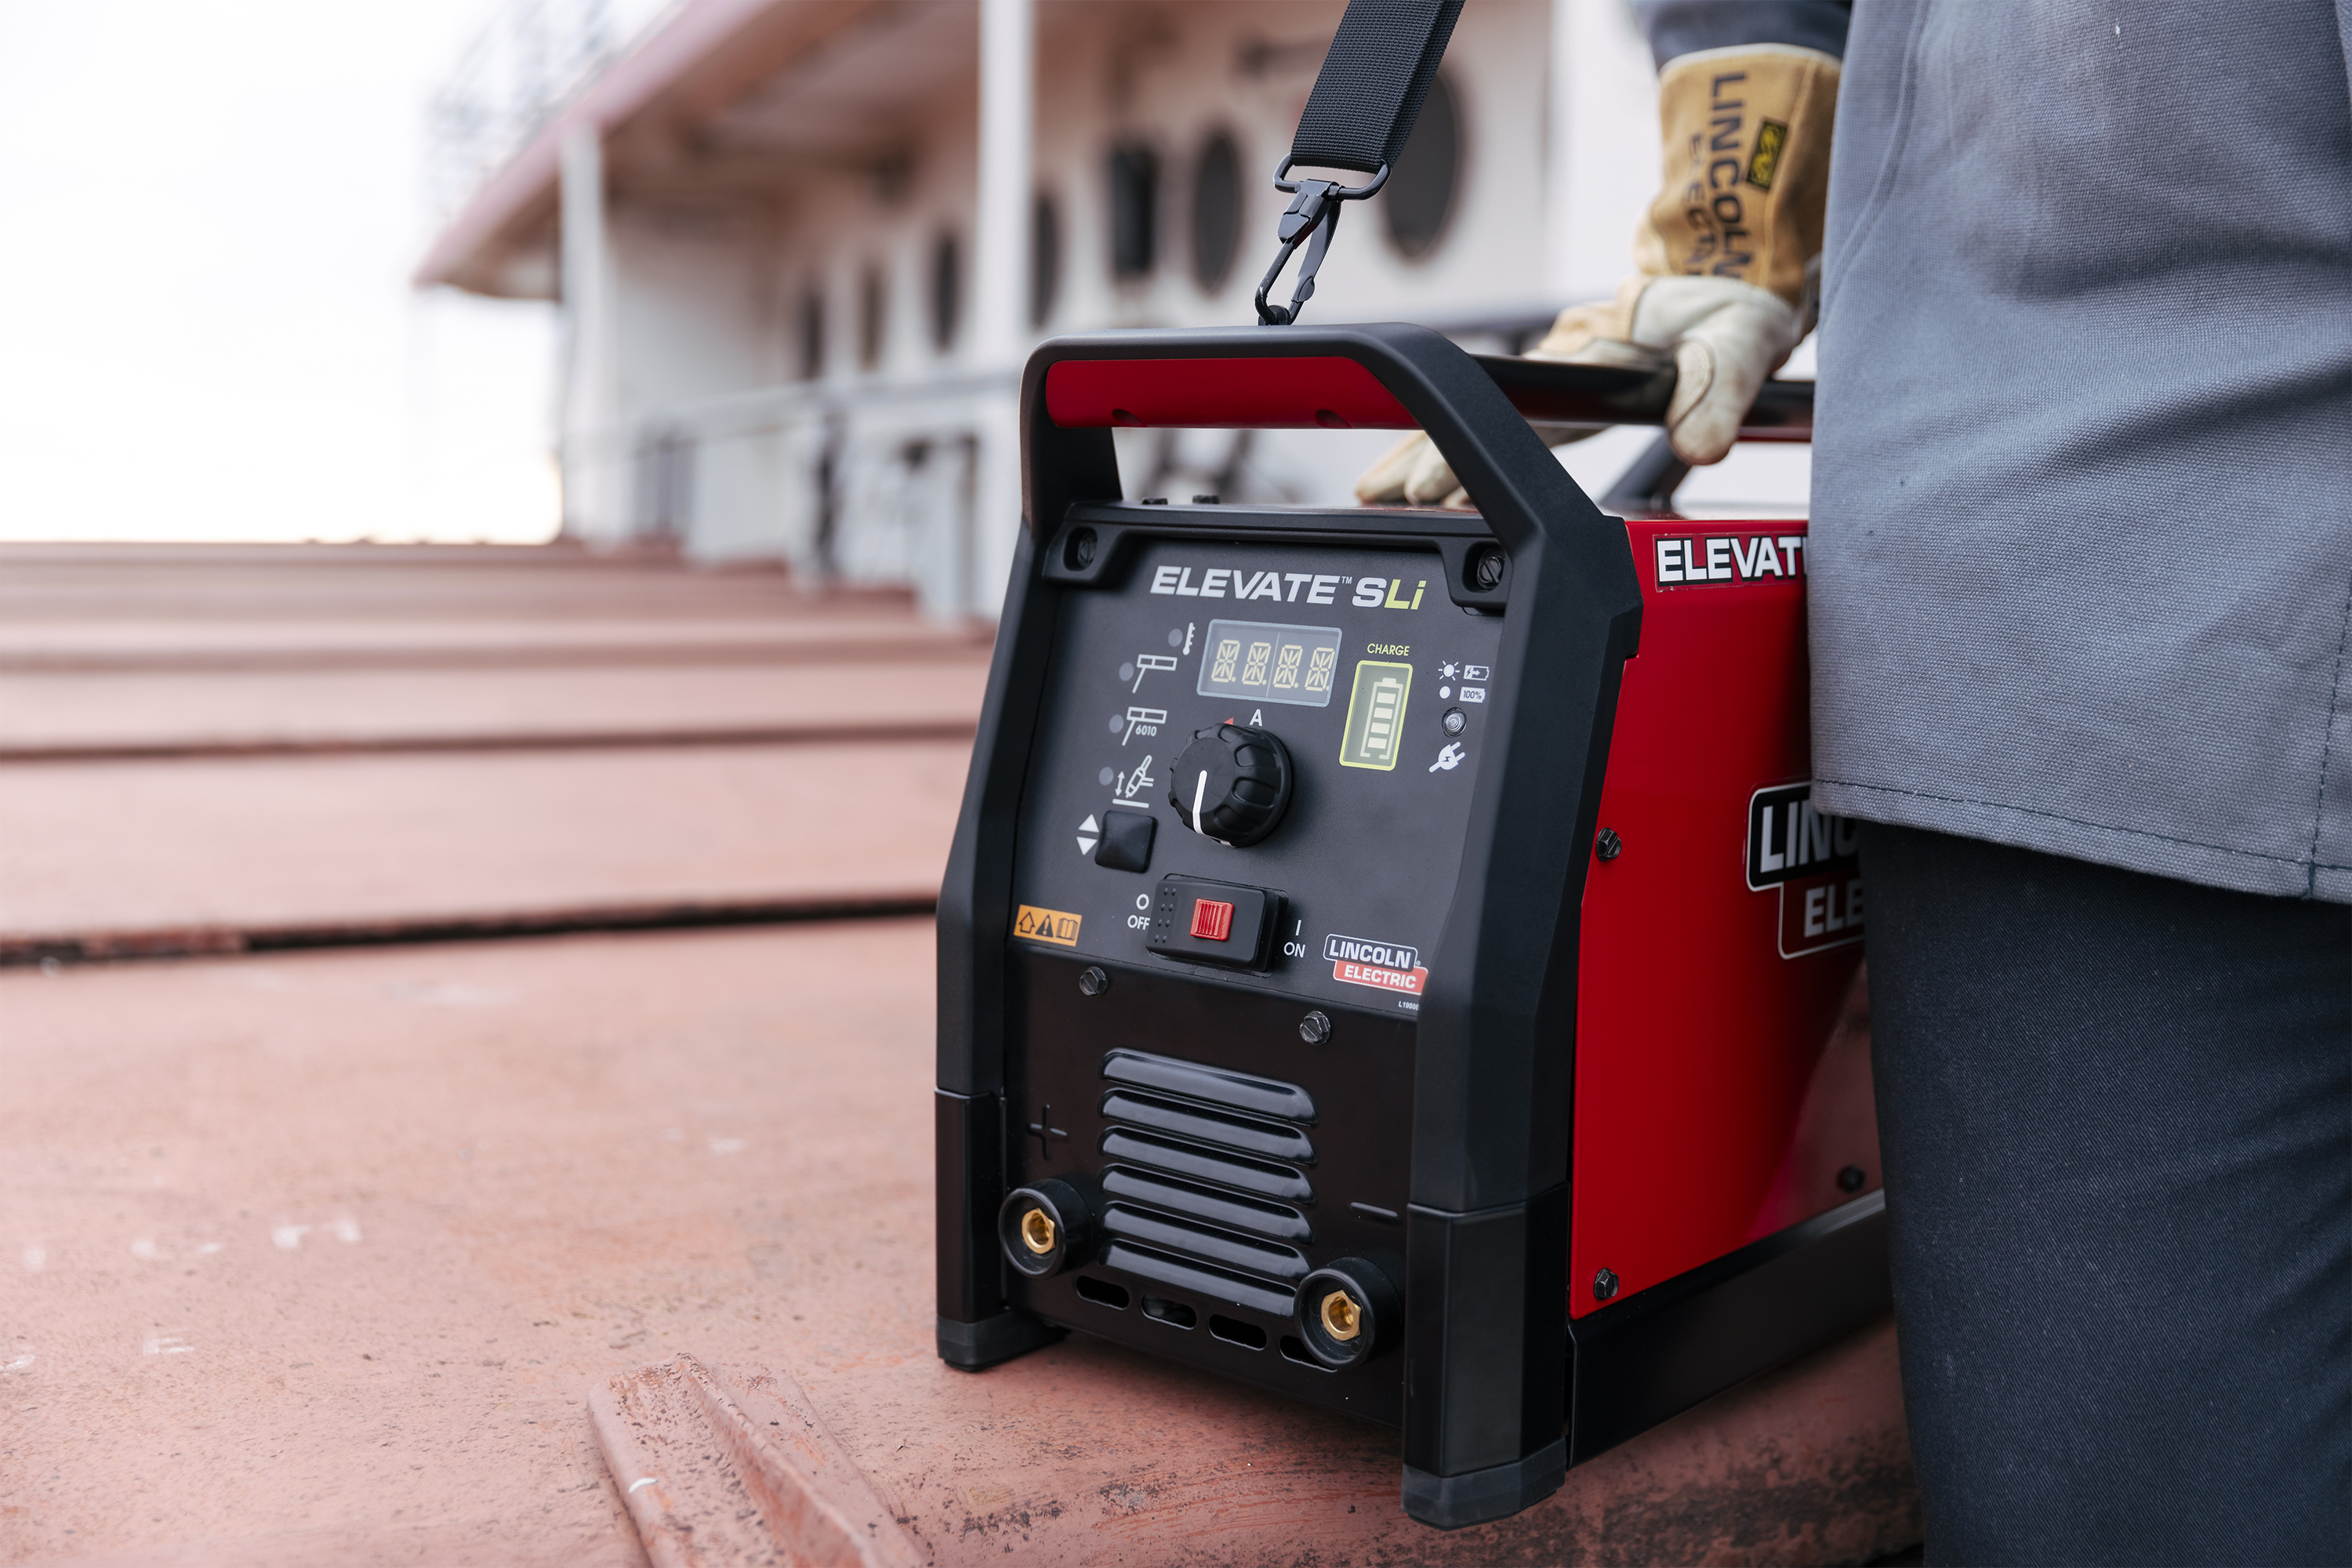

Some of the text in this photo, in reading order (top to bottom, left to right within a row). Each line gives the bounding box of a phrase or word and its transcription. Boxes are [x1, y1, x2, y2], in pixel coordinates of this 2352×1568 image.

[1657, 536, 1808, 582] ELEVAT
[1352, 577, 1427, 610] SLi
[1367, 643, 1410, 656] CHARGE
[1463, 690, 1482, 699] 100%
[1249, 709, 1263, 727] A
[1135, 724, 1157, 737] 6010
[1127, 914, 1150, 931] OFF
[1283, 942, 1305, 958] ON
[1329, 939, 1411, 969] LINCOLN
[1344, 964, 1417, 989] ELECTRIC
